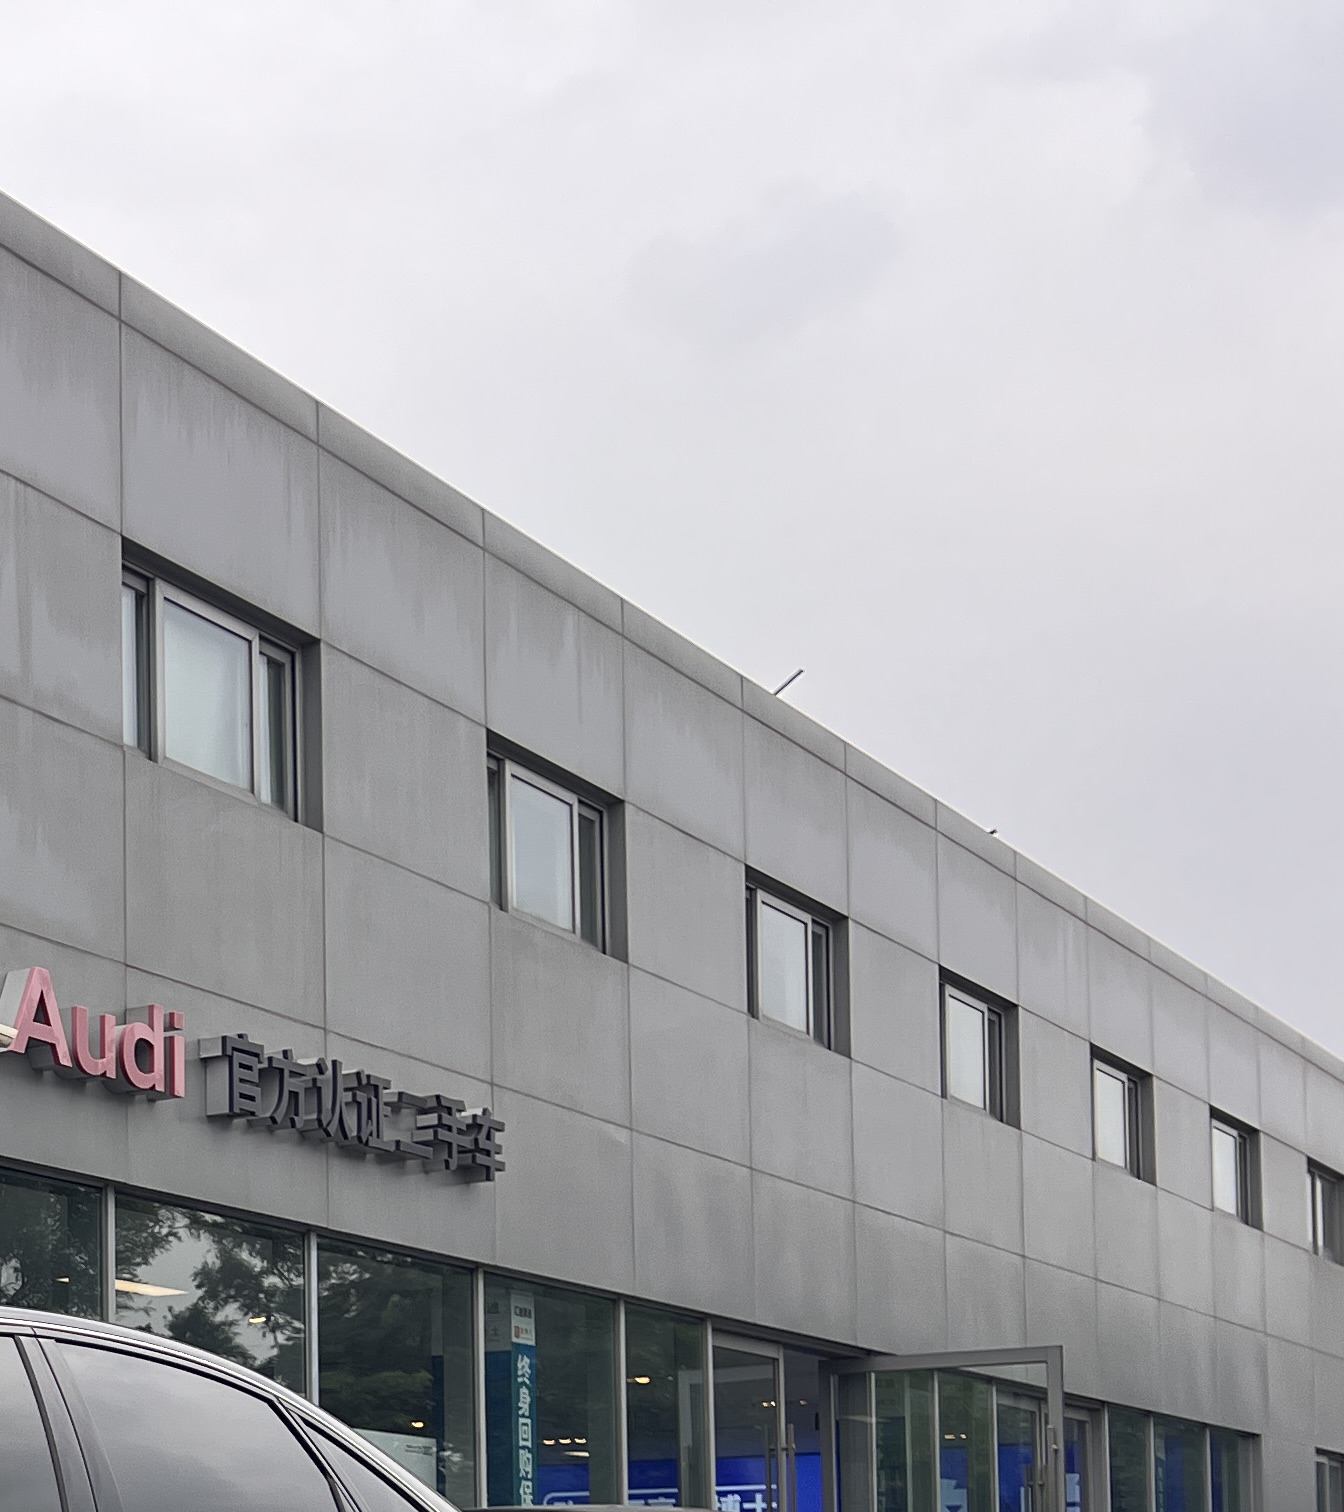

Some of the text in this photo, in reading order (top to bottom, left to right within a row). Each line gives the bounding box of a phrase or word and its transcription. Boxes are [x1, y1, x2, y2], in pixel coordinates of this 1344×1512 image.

[5, 965, 507, 1183] Audi 官方认证二手车
